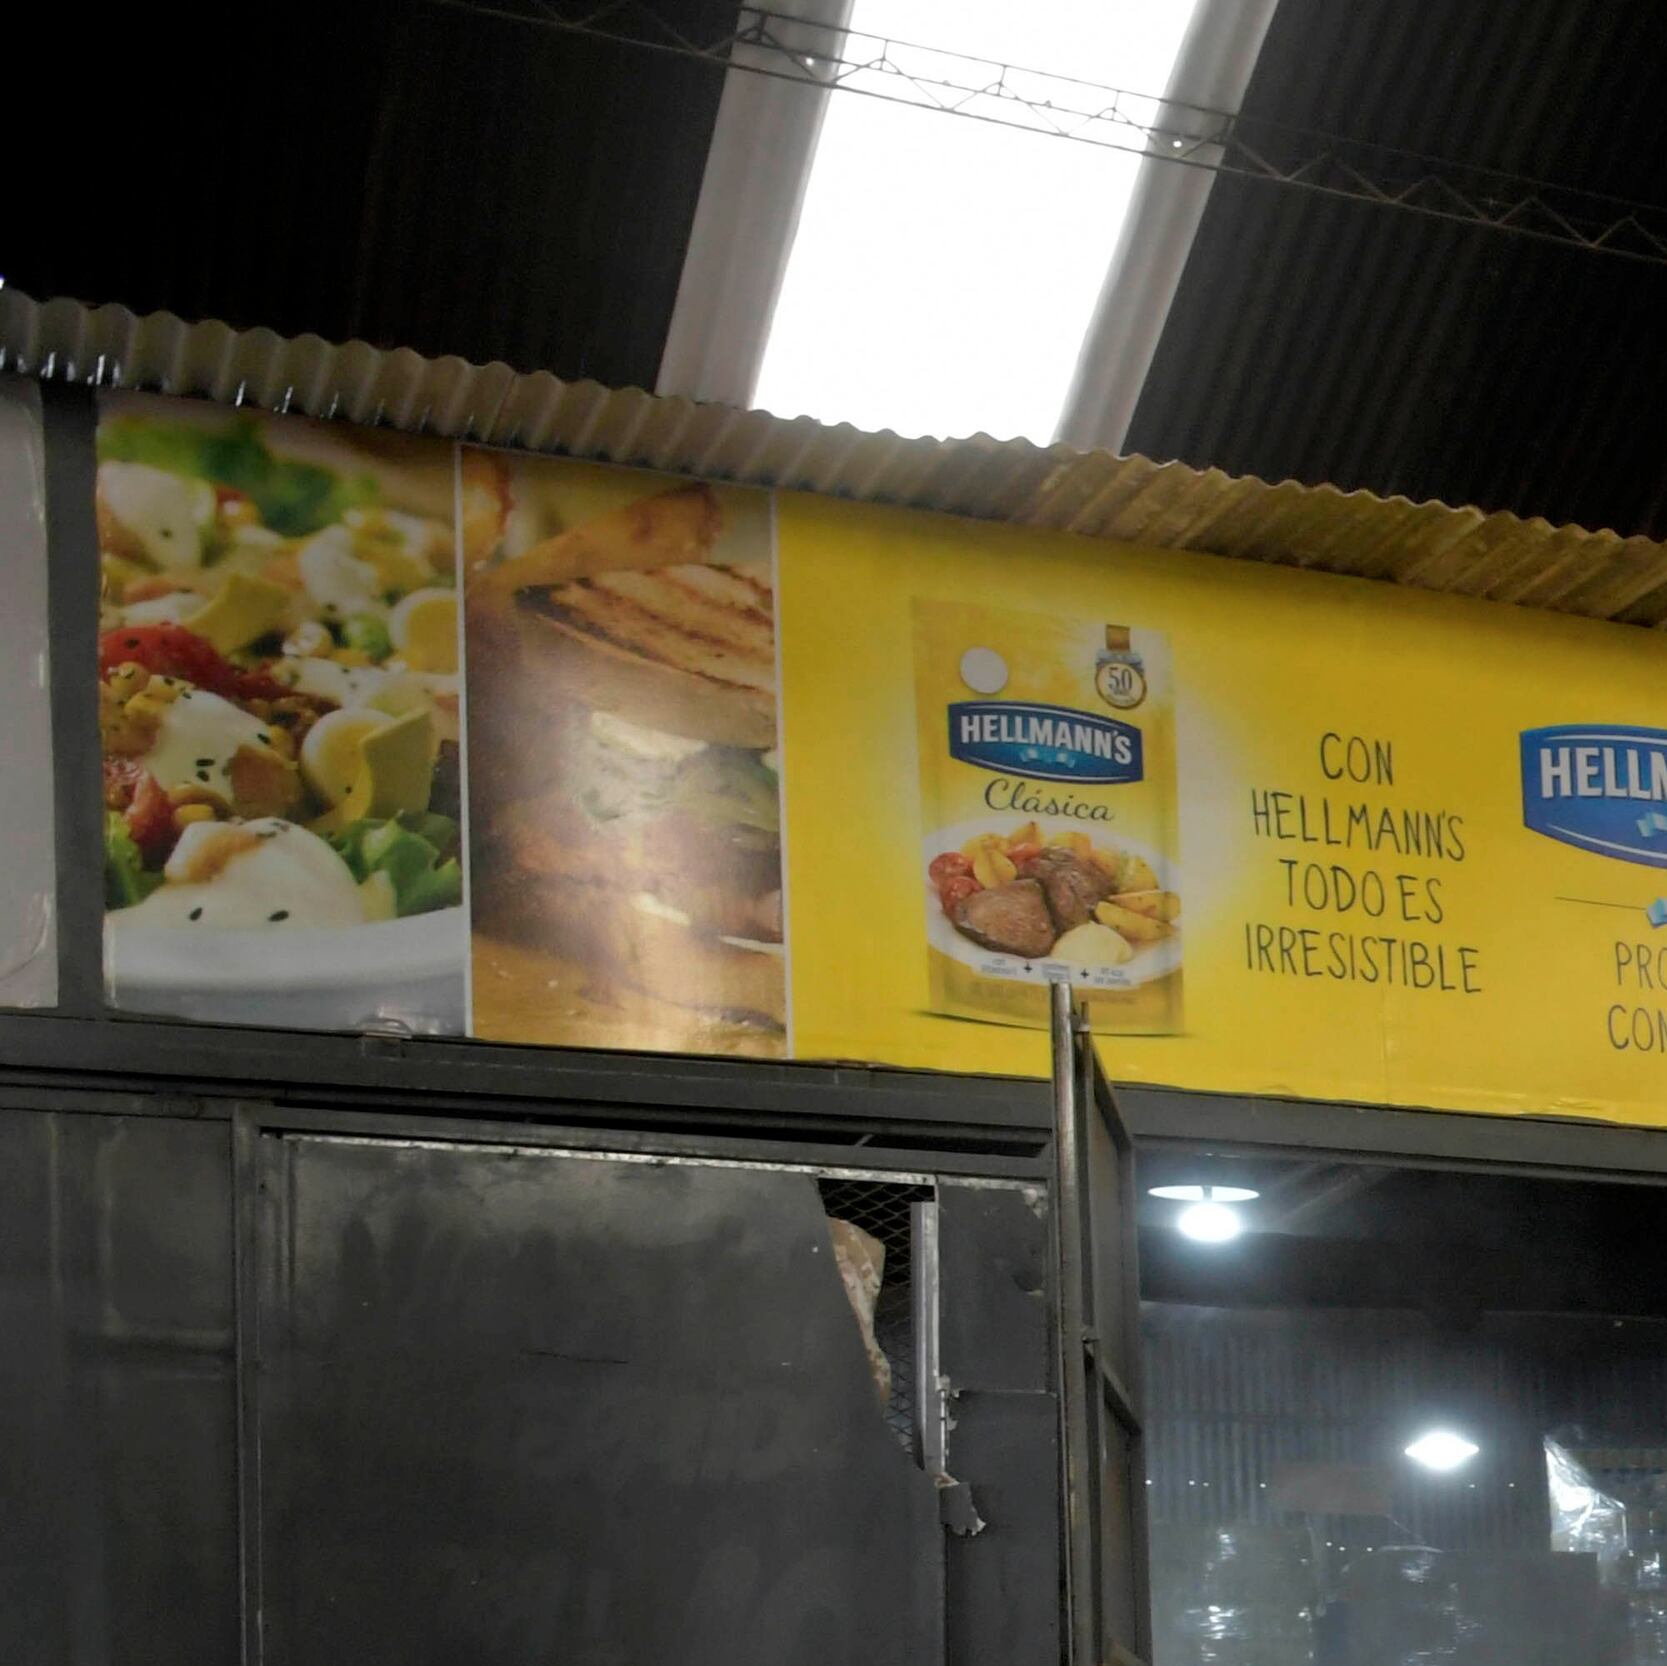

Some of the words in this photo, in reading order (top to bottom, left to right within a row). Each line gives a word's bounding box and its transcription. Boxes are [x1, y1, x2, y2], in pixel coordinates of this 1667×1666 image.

[960, 713, 1132, 765] HELLMANN'S
[1320, 732, 1393, 786] CON
[984, 778, 1113, 821] Clásica
[1252, 788, 1465, 862] HELLMANN'S
[1278, 858, 1386, 918] TODO
[1396, 874, 1443, 924] ES
[1246, 922, 1482, 994] IRRESISTIBLE
